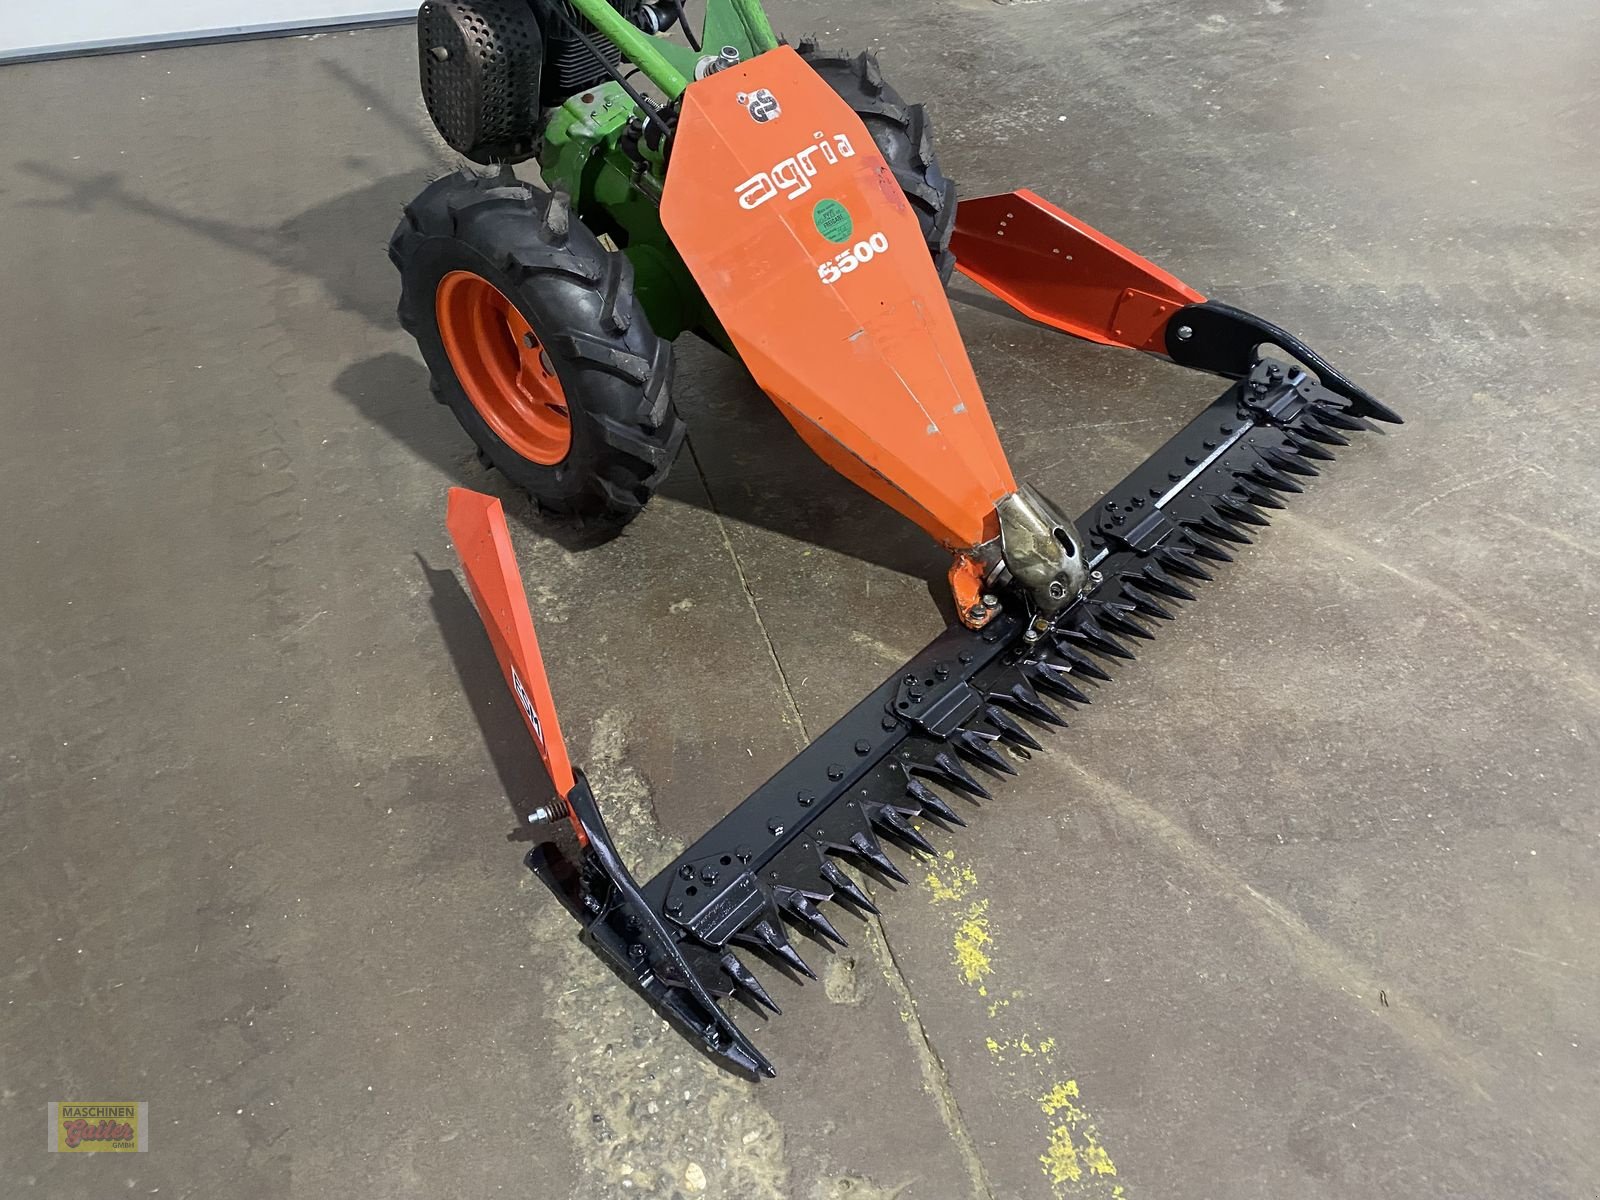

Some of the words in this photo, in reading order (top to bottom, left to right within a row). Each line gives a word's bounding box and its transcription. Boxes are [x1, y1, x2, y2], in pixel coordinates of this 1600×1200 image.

[749, 89, 778, 123] GS
[734, 130, 856, 210] agria
[817, 231, 889, 284] 5500
